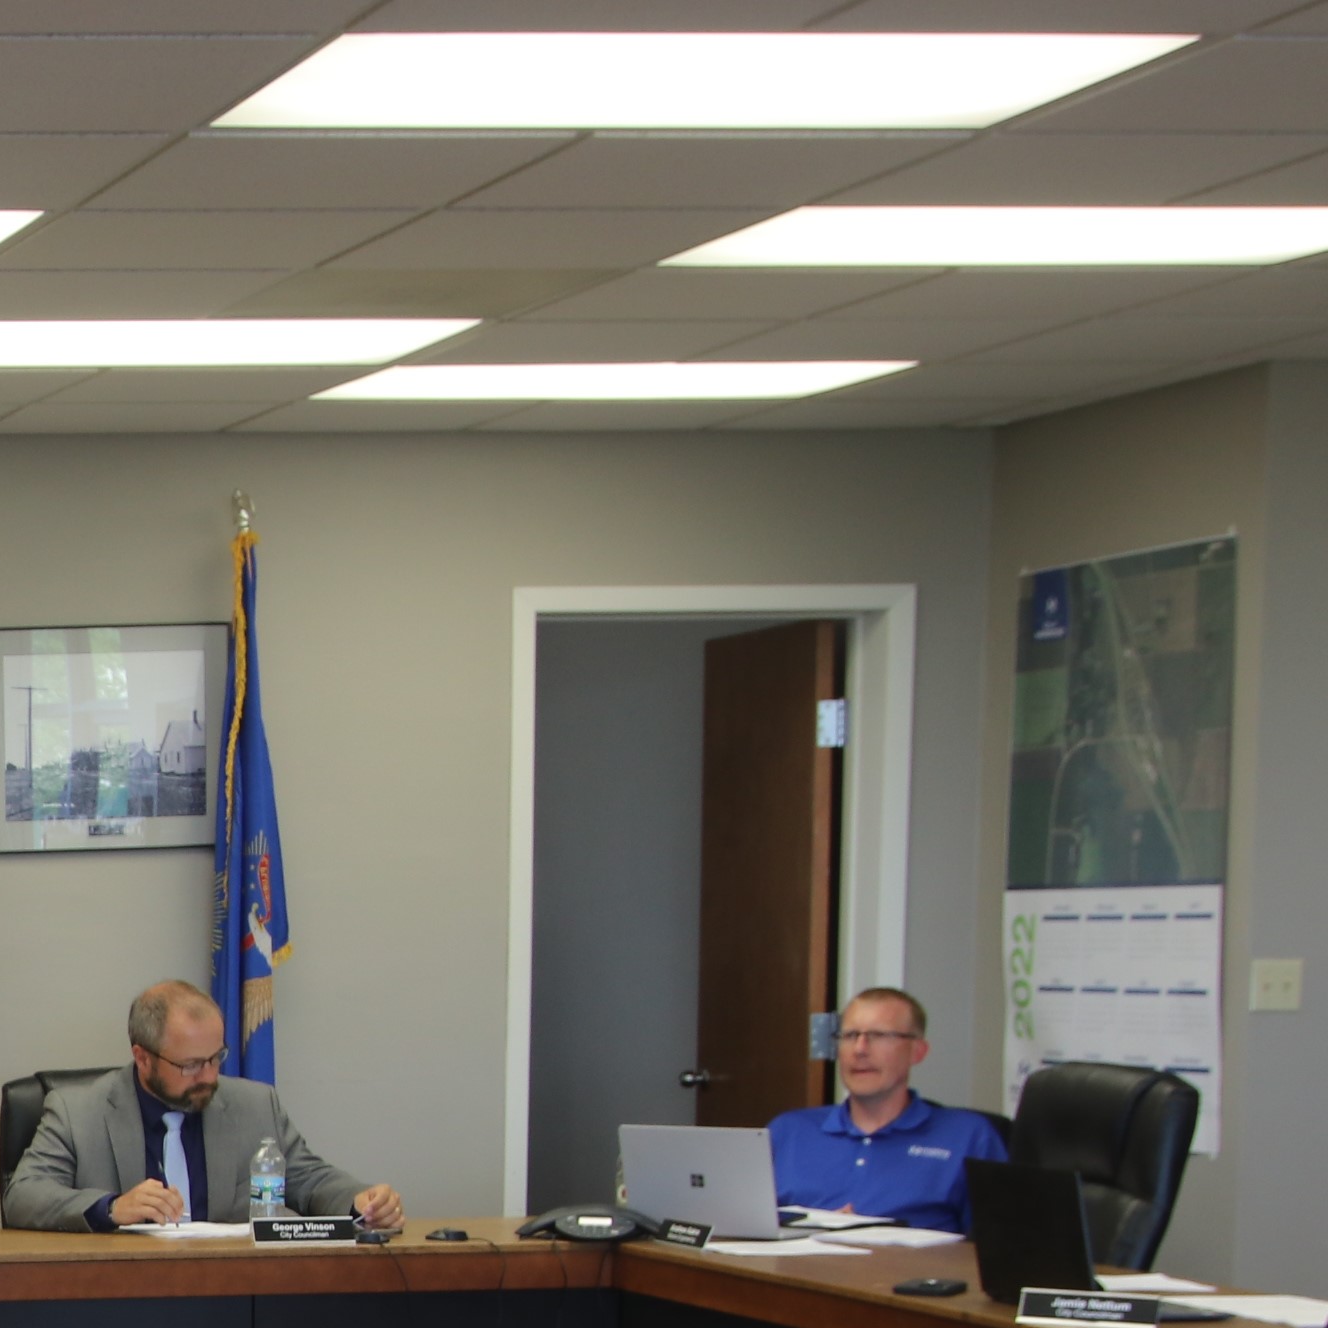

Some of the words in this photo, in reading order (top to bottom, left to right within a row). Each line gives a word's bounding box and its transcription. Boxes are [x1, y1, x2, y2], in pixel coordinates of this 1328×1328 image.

[1011, 913, 1036, 1040] 2022
[272, 1223, 304, 1234] George
[305, 1222, 335, 1231] Vinson
[280, 1232, 292, 1240] City
